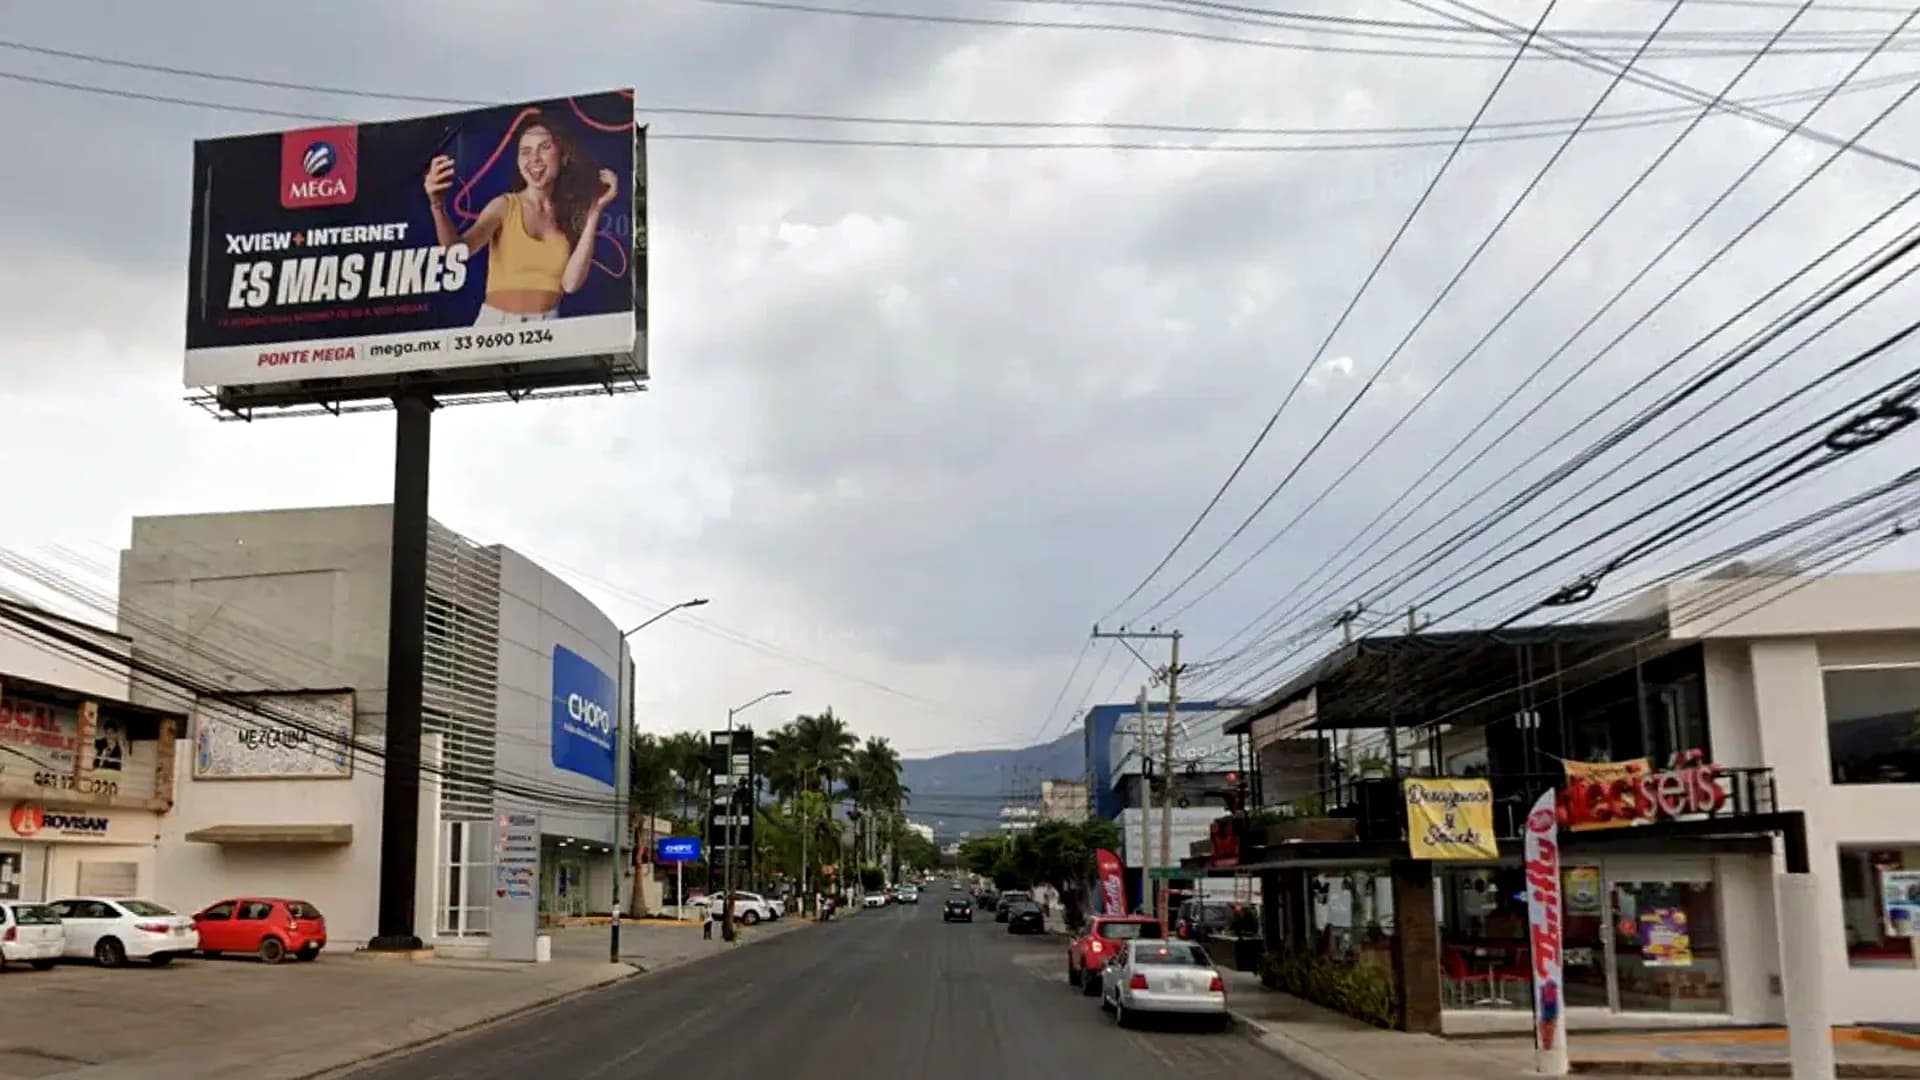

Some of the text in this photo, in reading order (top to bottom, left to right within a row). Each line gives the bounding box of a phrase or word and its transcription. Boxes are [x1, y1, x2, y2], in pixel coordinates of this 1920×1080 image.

[289, 178, 347, 199] MEGA
[225, 231, 292, 255] XVIEW
[306, 222, 408, 247] INTERNET
[228, 242, 470, 309] ES MAS LIKES
[370, 339, 441, 358] mega.mx
[454, 328, 554, 351] 33 9690 1234
[257, 345, 356, 367] PONTE MEGA
[567, 692, 610, 736] CHOPO
